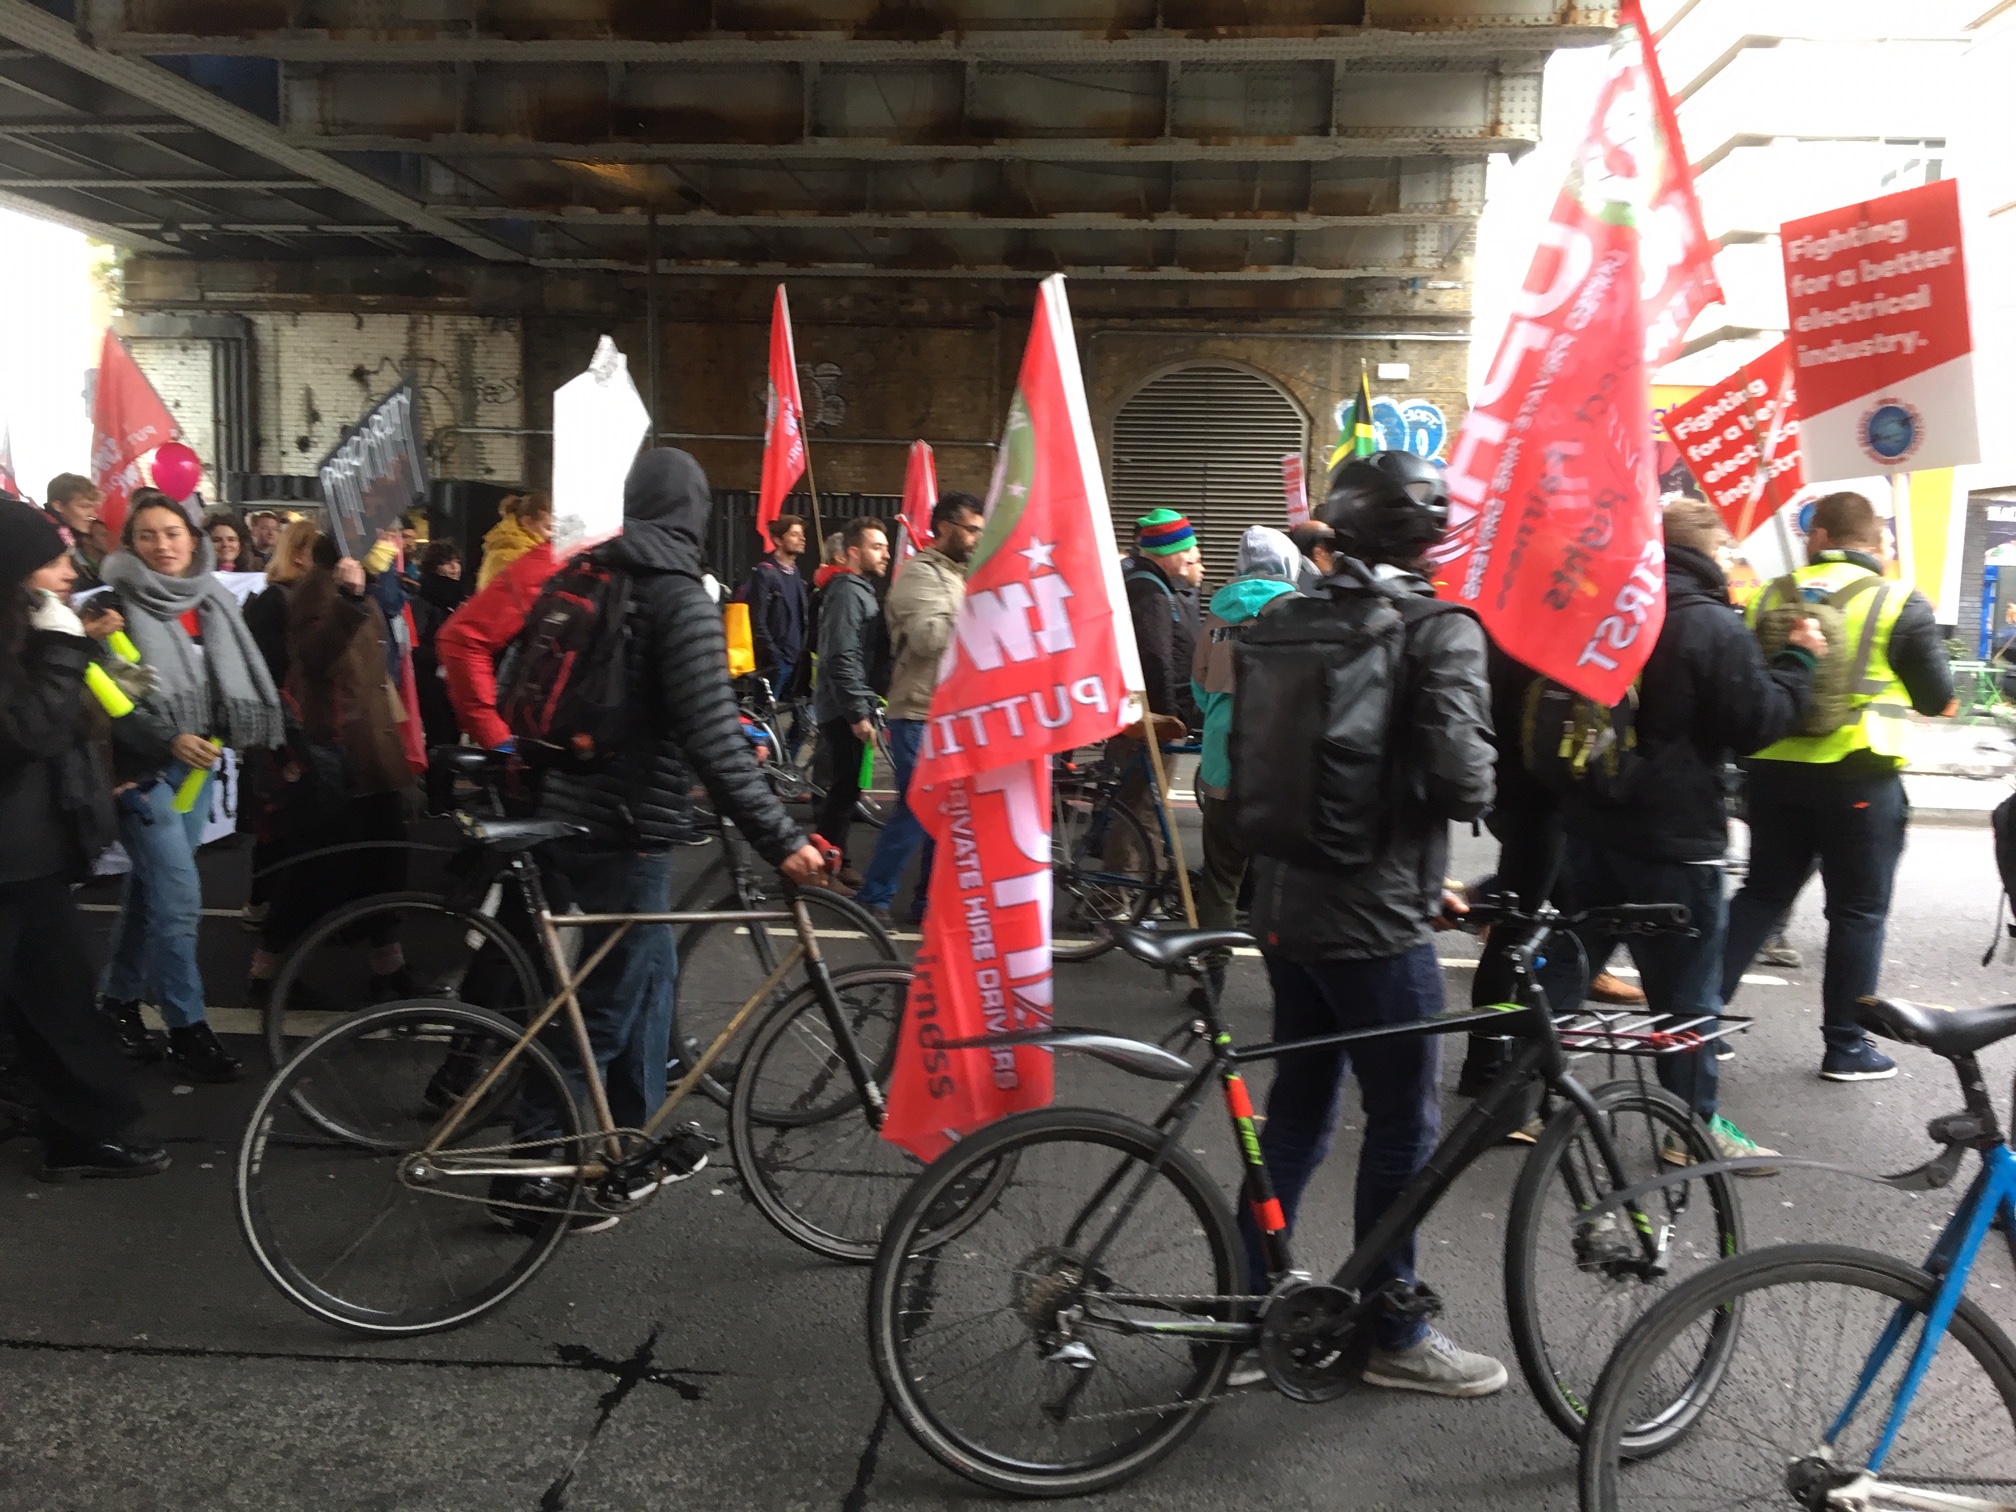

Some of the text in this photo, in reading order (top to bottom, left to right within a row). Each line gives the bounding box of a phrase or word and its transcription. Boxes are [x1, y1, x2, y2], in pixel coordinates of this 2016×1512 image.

[1787, 218, 1909, 262] Fighting
[1791, 246, 1957, 297] for a better
[1794, 283, 1932, 332] electrical
[1798, 331, 1930, 367] industry.
[1672, 379, 1769, 440] Fighting
[1687, 435, 1723, 462] for
[1723, 425, 1744, 440] a
[962, 896, 997, 962] HIRE
